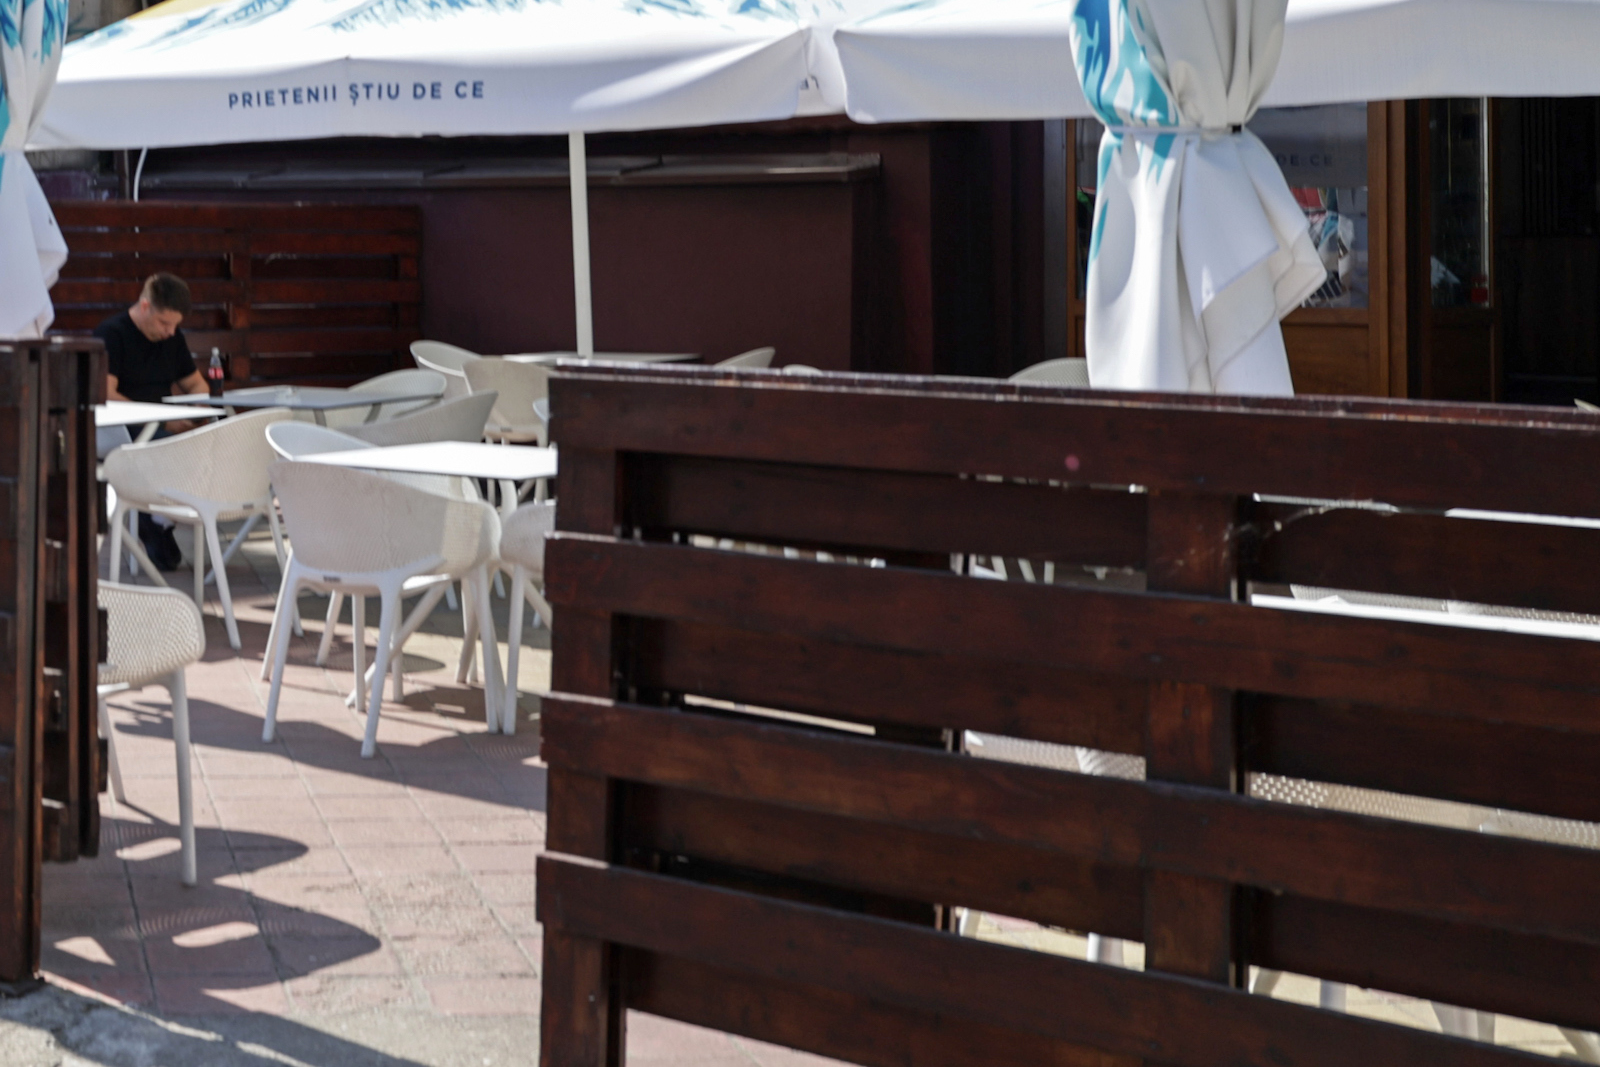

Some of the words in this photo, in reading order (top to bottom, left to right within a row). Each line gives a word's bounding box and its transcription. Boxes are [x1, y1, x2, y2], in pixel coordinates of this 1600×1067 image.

[228, 84, 338, 109] PRIETENII
[413, 81, 442, 100] DE
[455, 80, 485, 99] CE
